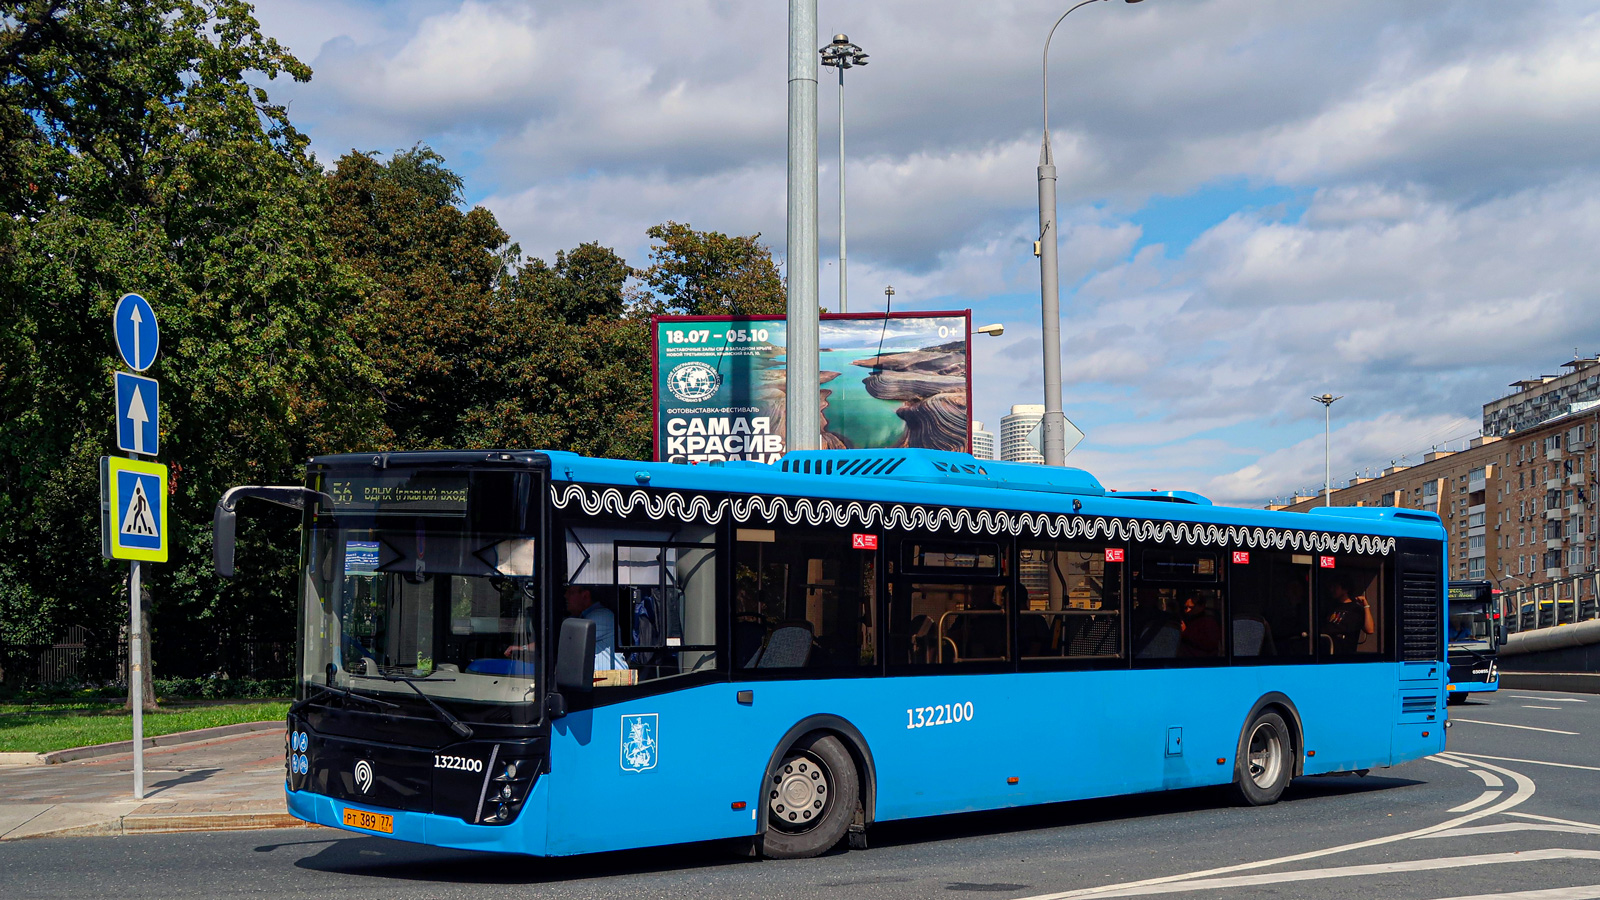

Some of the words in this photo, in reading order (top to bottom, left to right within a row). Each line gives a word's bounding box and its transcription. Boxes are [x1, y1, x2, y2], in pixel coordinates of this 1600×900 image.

[666, 330, 710, 343] 18.07
[726, 329, 769, 342] 05.10
[938, 325, 957, 339] 0+
[667, 416, 770, 436] САМАЯ
[667, 435, 786, 454] КРАСИВ
[333, 482, 353, 504] 56
[364, 487, 392, 501] ВДНХ
[906, 701, 974, 729] 1322100
[434, 755, 483, 772] 1322100
[360, 813, 376, 828] 389
[381, 816, 390, 827] 77
